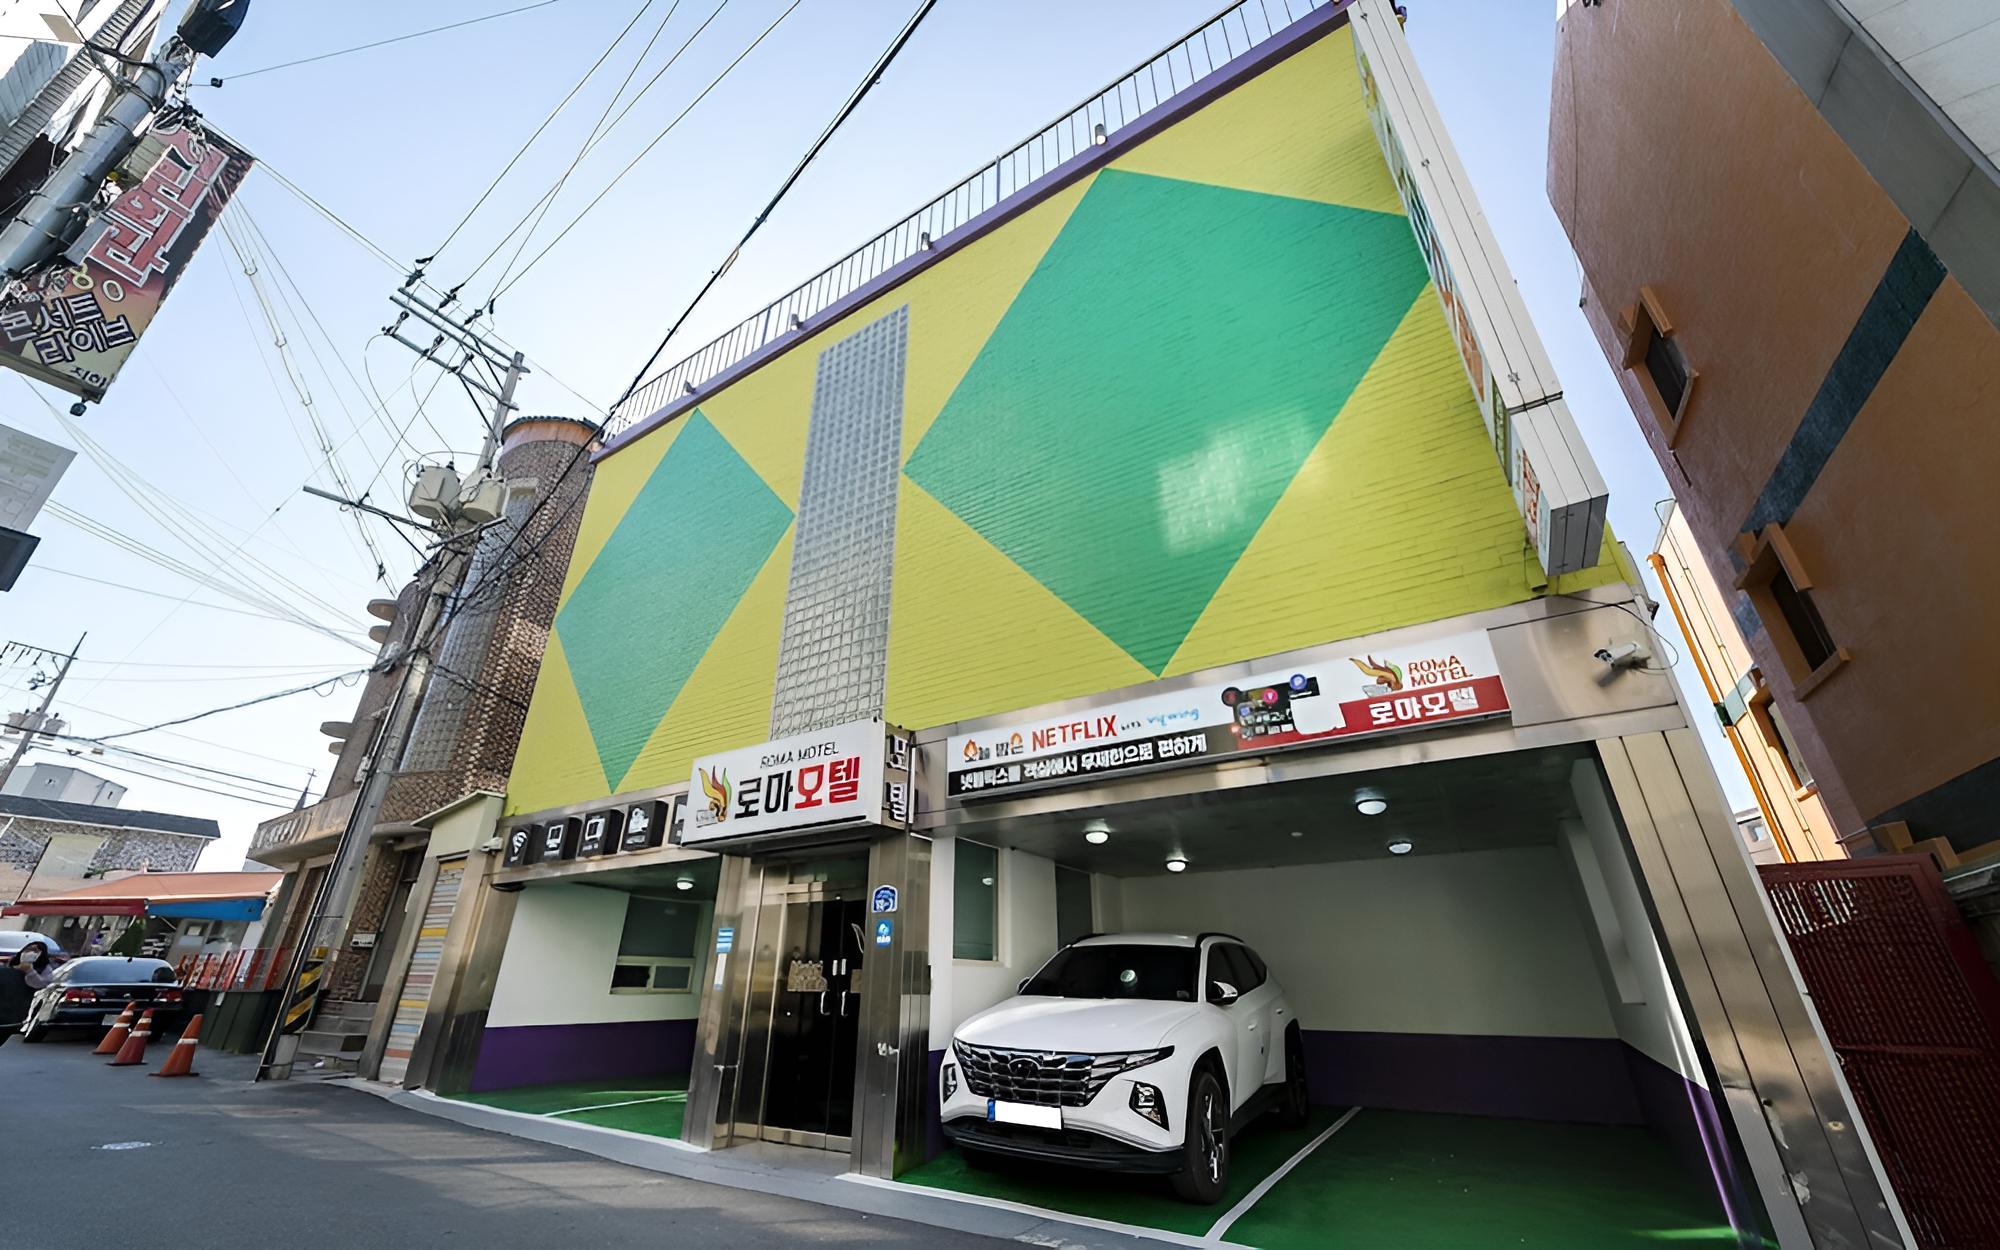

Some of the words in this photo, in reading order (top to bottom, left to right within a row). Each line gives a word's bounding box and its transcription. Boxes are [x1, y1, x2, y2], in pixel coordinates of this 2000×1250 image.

[1, 293, 103, 341] 콘서트
[33, 314, 137, 365] 라이브
[1408, 655, 1461, 675] ROMA
[1410, 666, 1474, 688] MOTEL
[1031, 714, 1118, 752] NETFLIX
[760, 751, 794, 769] ROMA
[797, 741, 839, 761] MOTEL
[734, 756, 860, 820] 로마모텔
